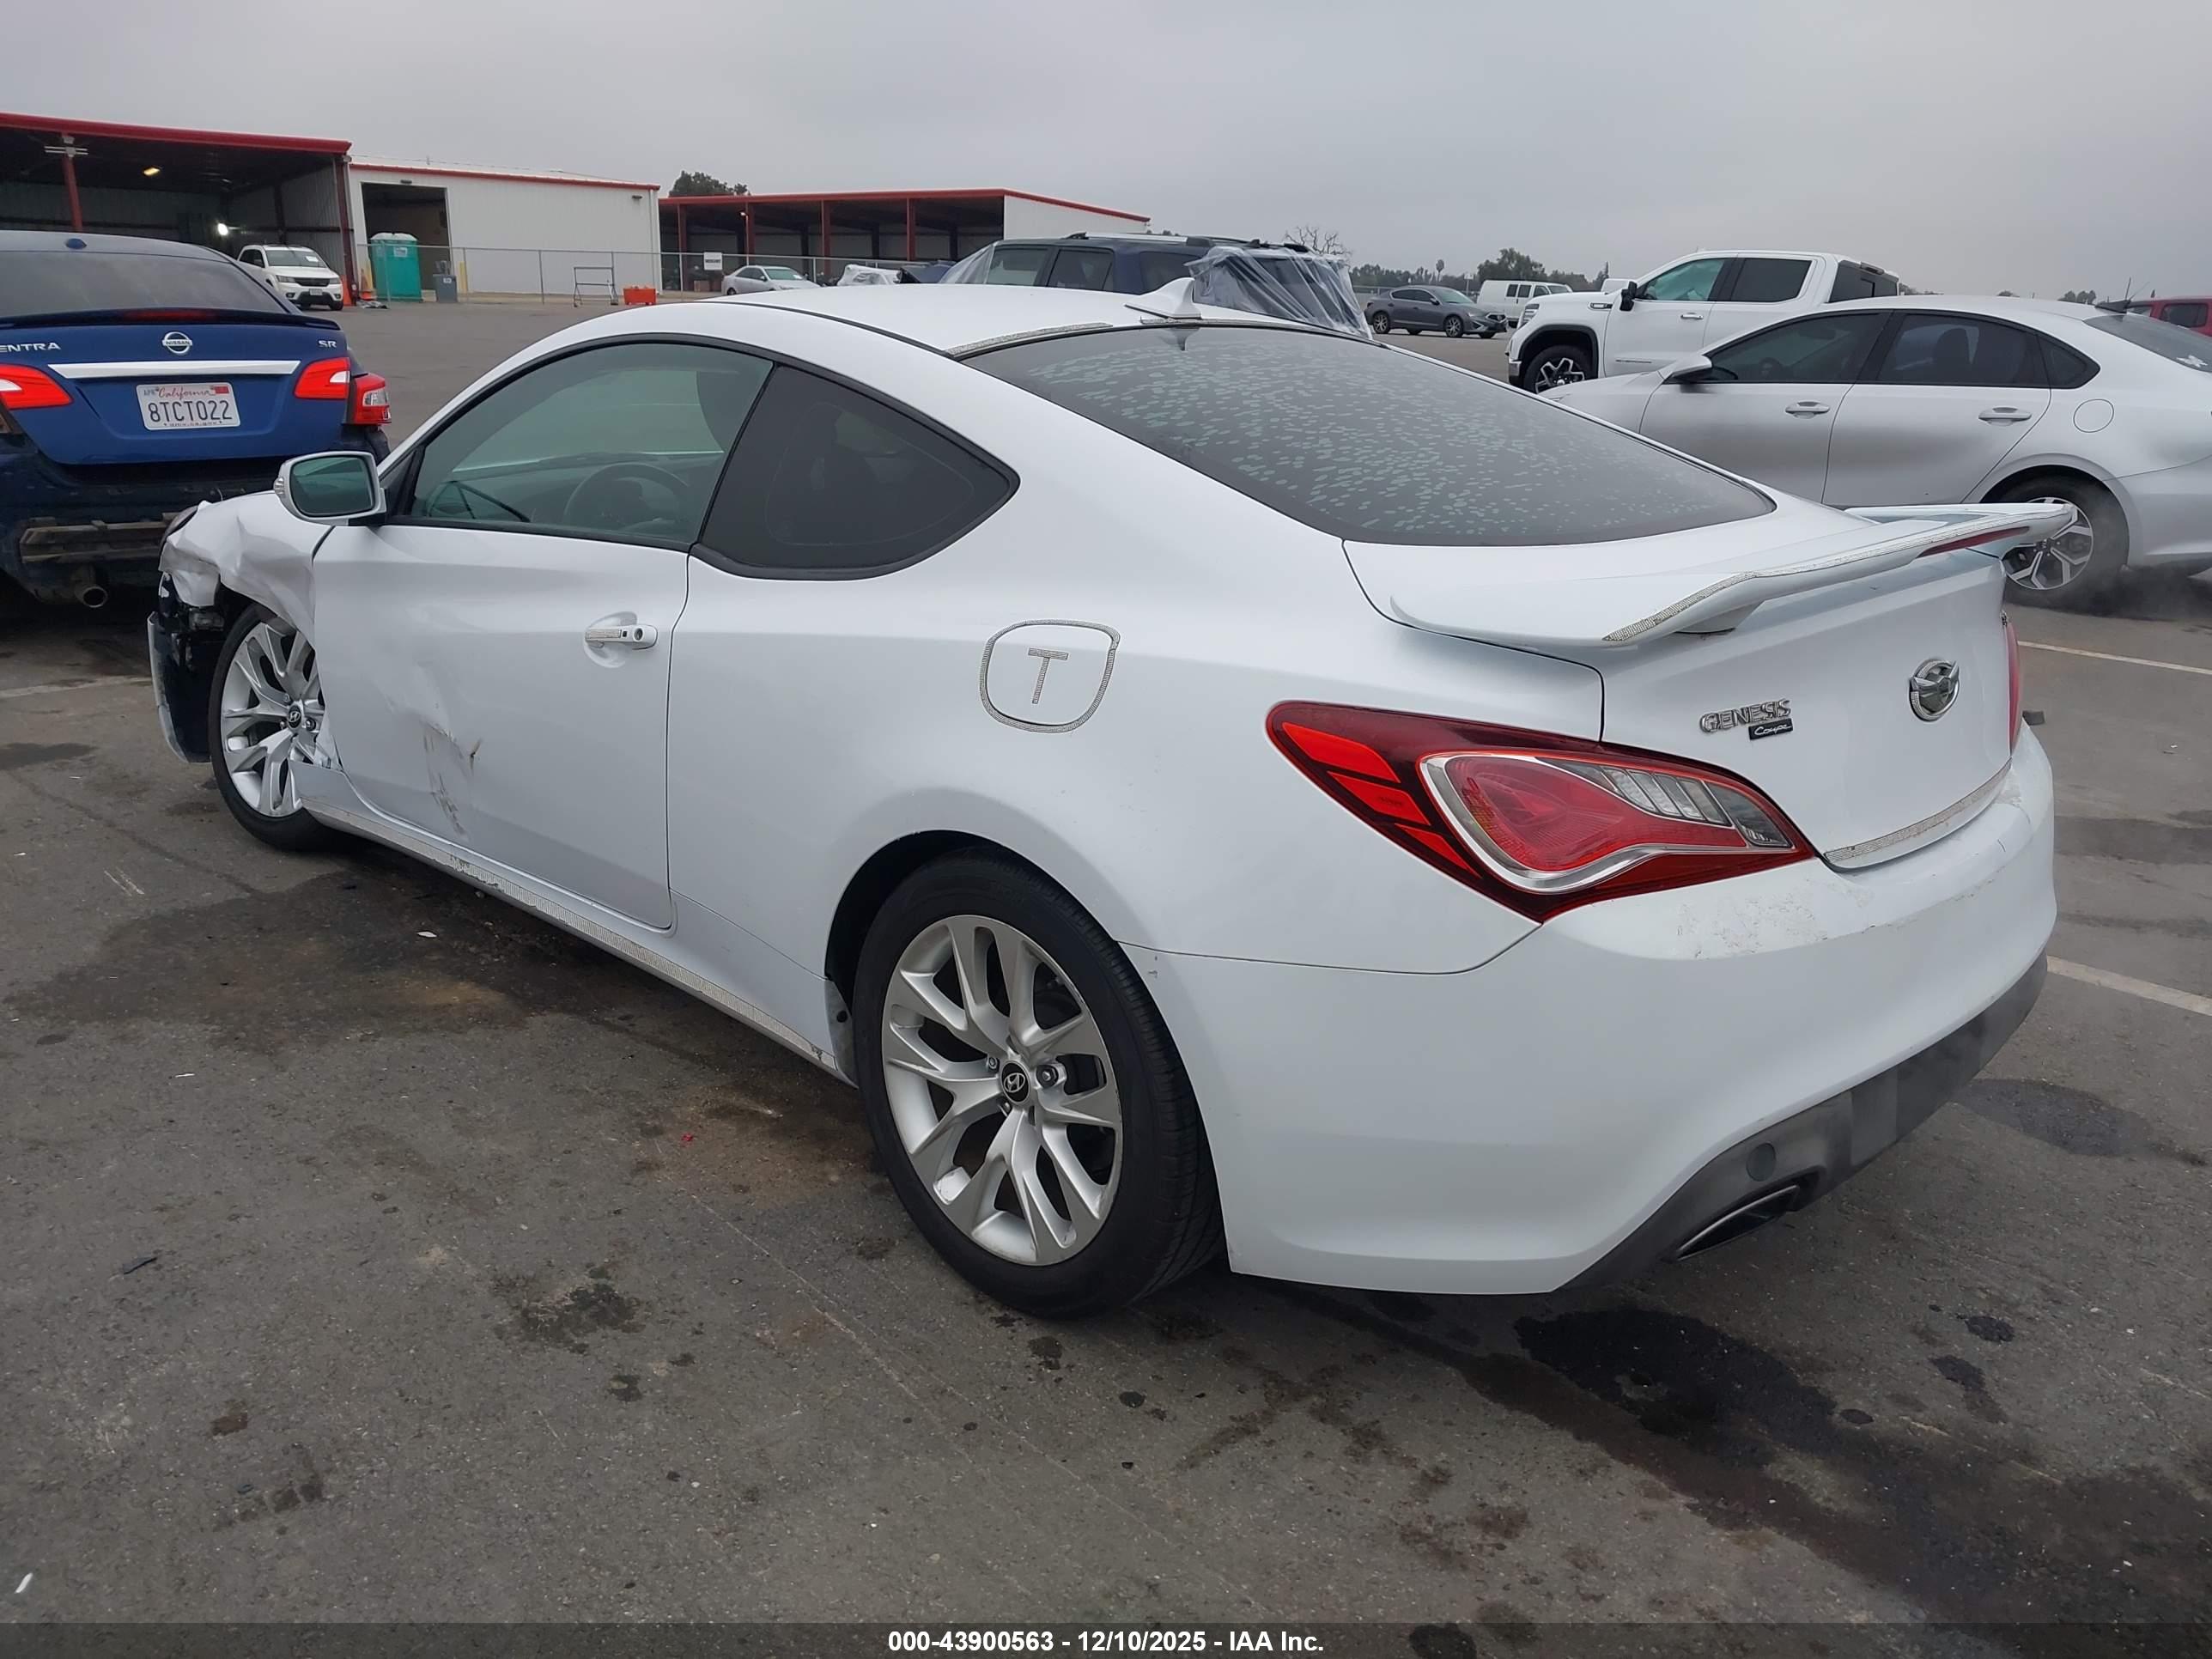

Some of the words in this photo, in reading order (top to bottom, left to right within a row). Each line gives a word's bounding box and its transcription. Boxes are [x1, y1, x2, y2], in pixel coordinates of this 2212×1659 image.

[158, 386, 216, 400] California
[148, 400, 233, 422] 8TCT022
[1699, 698, 1791, 732] GENESIS
[1753, 724, 1792, 736] Coupe
